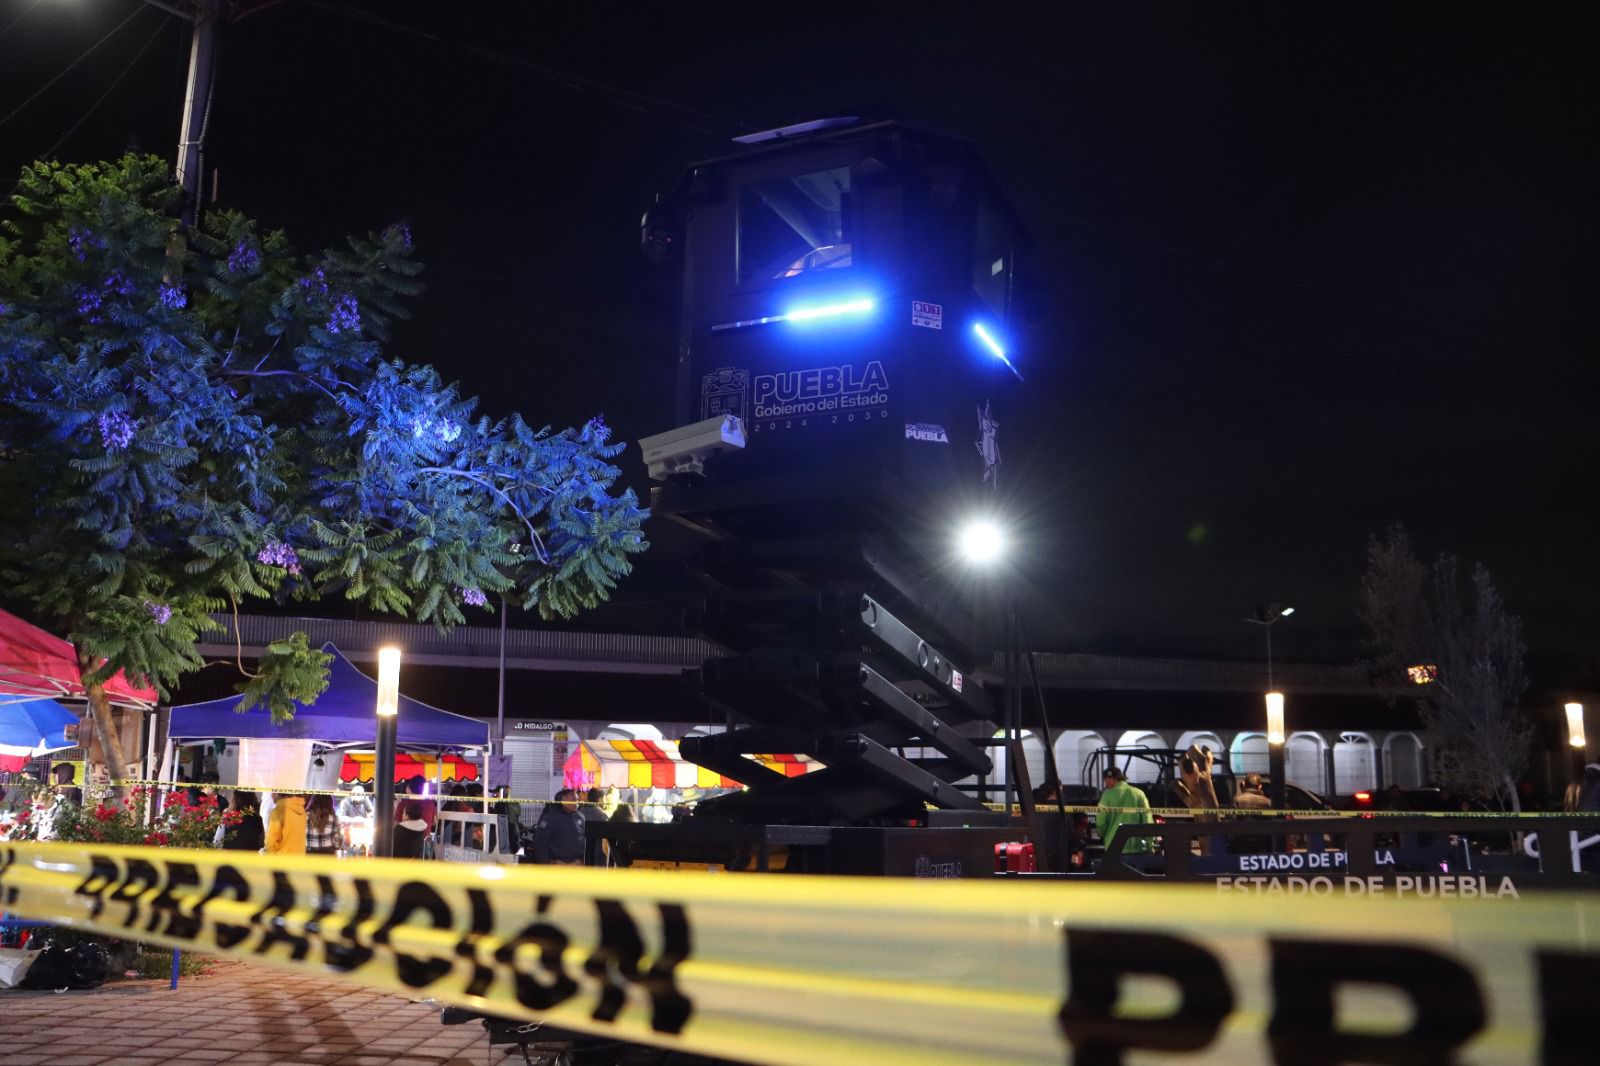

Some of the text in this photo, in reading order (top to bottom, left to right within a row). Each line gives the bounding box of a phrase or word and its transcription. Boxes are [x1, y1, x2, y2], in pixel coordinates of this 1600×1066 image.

[754, 361, 889, 405] PUEBLA
[755, 392, 888, 418] Gobierno del Estado
[905, 429, 949, 443] PUEBLA
[524, 722, 553, 730] HIDALGO
[1239, 854, 1304, 871] ESTADO
[1308, 852, 1330, 868] DE
[1216, 875, 1520, 899] ESTADO DE PUEBLA
